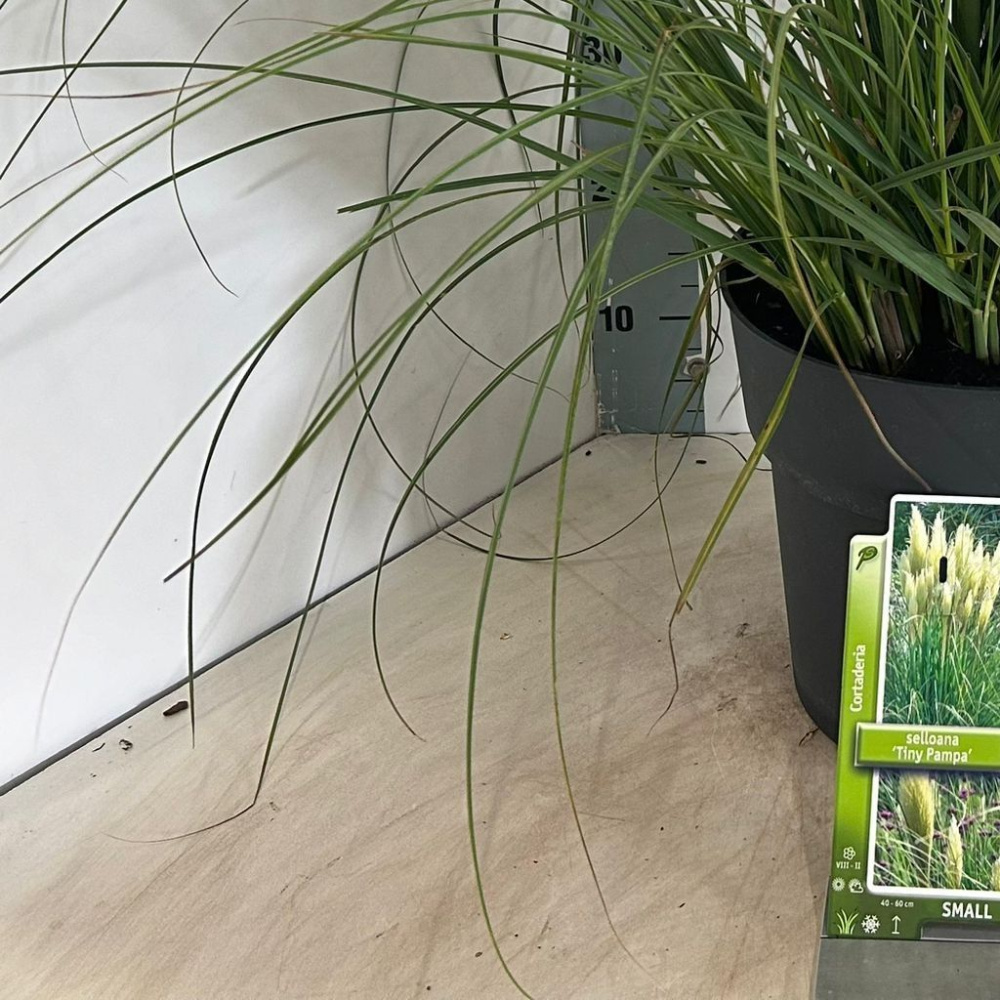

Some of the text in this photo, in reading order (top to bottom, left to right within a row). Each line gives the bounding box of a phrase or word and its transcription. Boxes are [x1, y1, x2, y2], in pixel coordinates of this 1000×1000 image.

[599, 305, 634, 332] 10
[849, 644, 866, 713] Cortaderia
[906, 730, 959, 746] selloana
[835, 861, 849, 869] VIII
[880, 898, 889, 907] 40
[942, 901, 992, 920] SMALL
